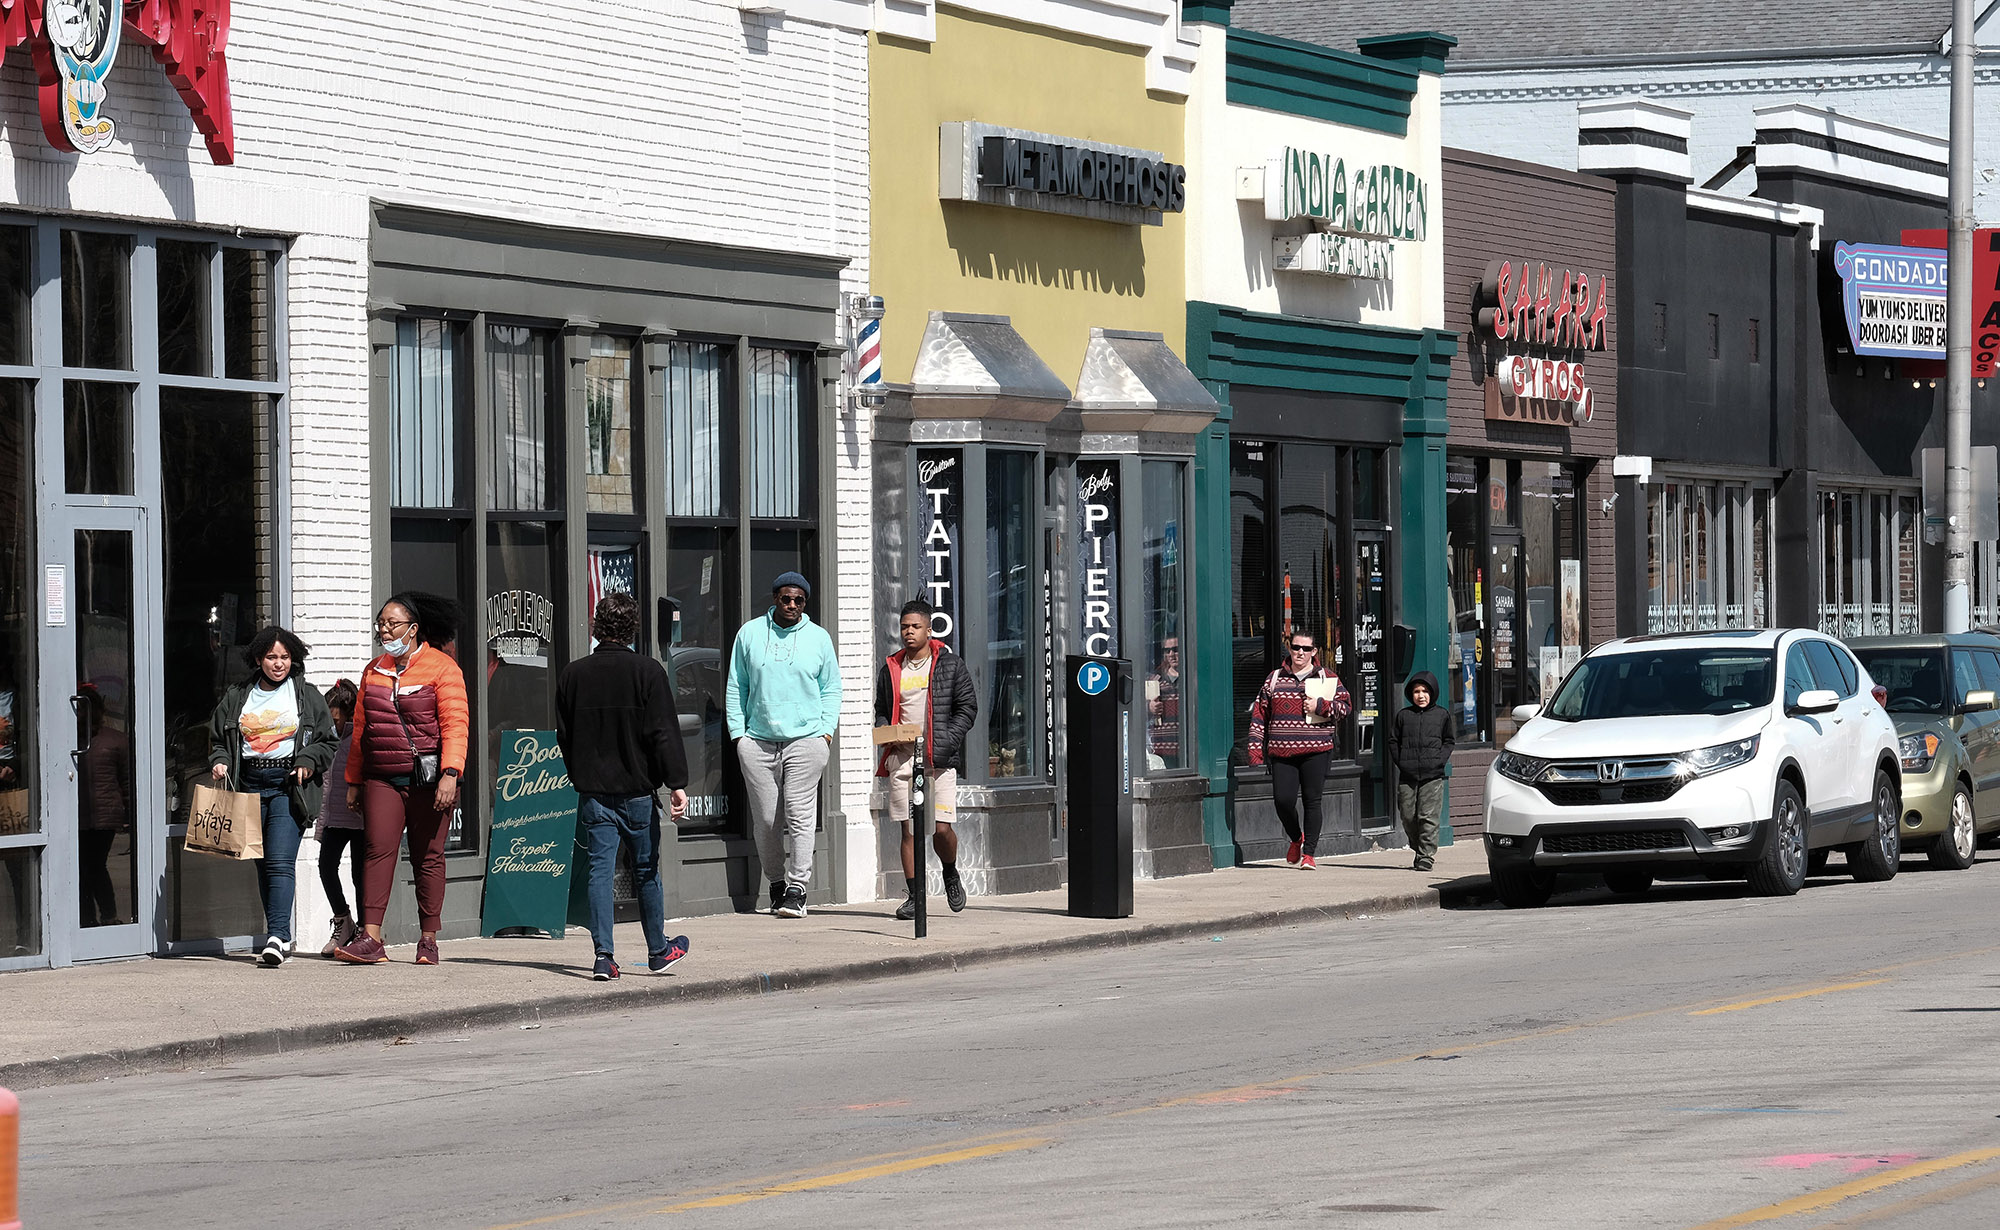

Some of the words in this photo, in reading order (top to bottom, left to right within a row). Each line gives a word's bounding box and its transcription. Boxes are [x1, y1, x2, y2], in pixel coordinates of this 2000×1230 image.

[1002, 137, 1187, 214] METAMORPHOSIS
[1283, 145, 1348, 231] INDIA
[1352, 164, 1428, 242] GARDEN
[1320, 232, 1395, 280] RESTAURANT
[1494, 260, 1608, 351] SAHARA
[1859, 298, 1878, 318] YUM
[1880, 299, 1905, 320] YUMS
[1859, 323, 1908, 344] DOORDASH
[1912, 325, 1935, 345] UBER
[1510, 355, 1585, 404] GYROS
[918, 457, 956, 484] Custom
[1079, 468, 1113, 501] Body
[925, 487, 954, 655] TATTO
[497, 637, 521, 657] BARBER
[522, 637, 539, 657] SHOP
[1087, 667, 1102, 690] P
[507, 736, 564, 771] Boo
[704, 795, 729, 816] SHAVES
[194, 803, 232, 845] pitaya
[510, 837, 559, 859] Expert
[491, 856, 566, 878] Haircutting
